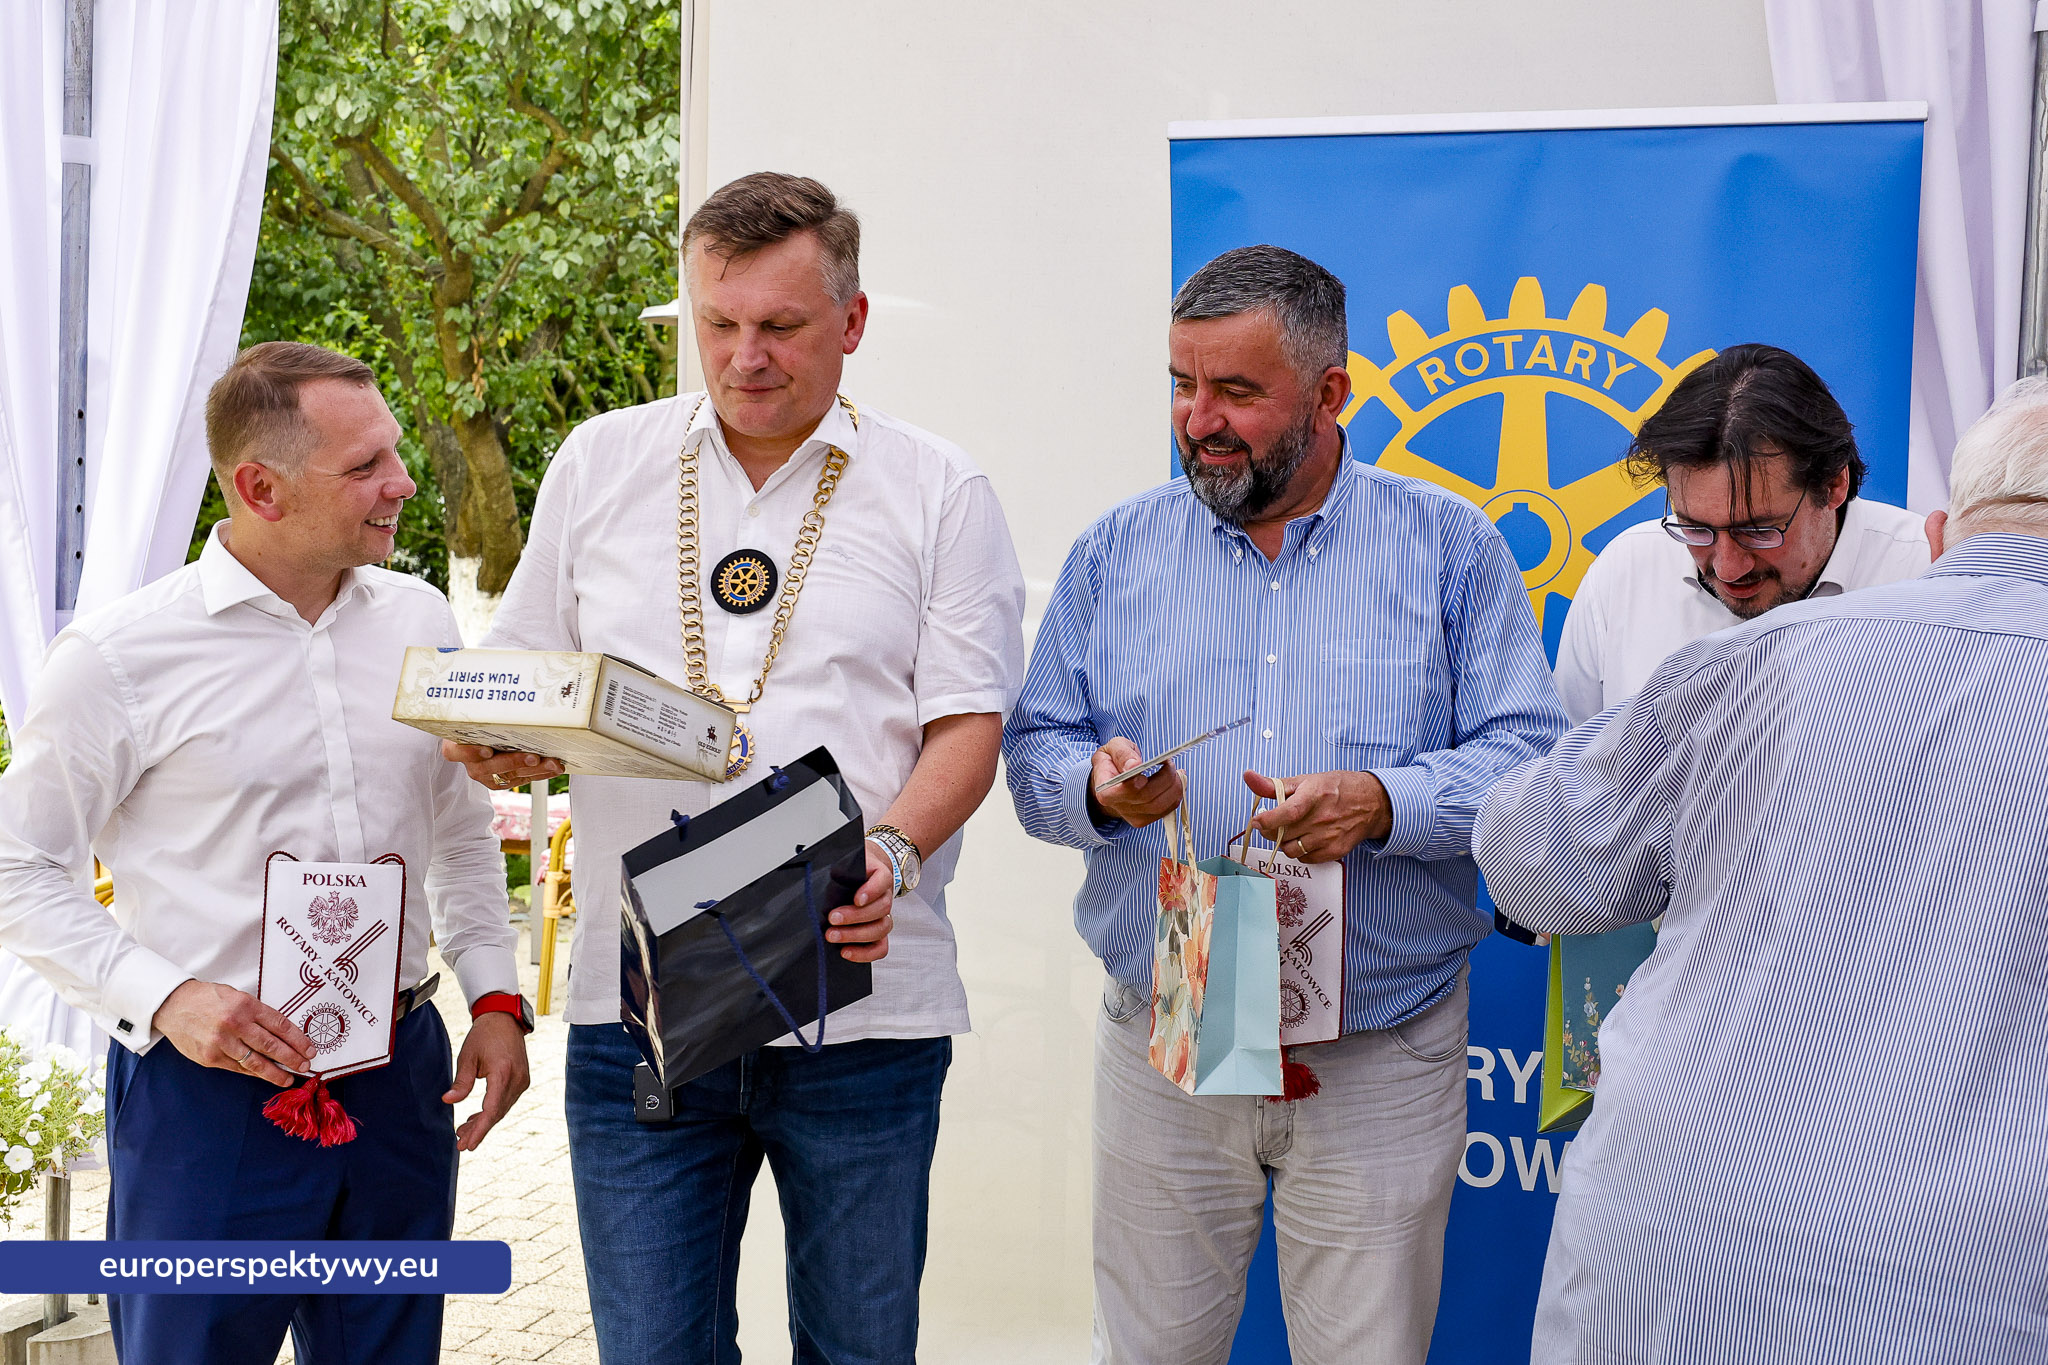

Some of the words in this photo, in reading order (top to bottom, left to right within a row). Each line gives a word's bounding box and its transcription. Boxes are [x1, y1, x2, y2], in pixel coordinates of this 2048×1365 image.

[1416, 335, 1637, 396] ROTARY
[447, 671, 485, 683] SPIRIT
[488, 673, 520, 684] PLUM
[426, 687, 484, 700] DISTILLED
[487, 689, 536, 702] DOUBLE
[1258, 860, 1312, 879] POLSKA
[302, 873, 367, 888] POLSKA
[275, 916, 322, 963] ROTARY
[323, 967, 379, 1027] KATOWICE
[1283, 948, 1333, 1010] KATOWICE
[1467, 1046, 1543, 1104] RY
[1457, 1131, 1573, 1194] OW
